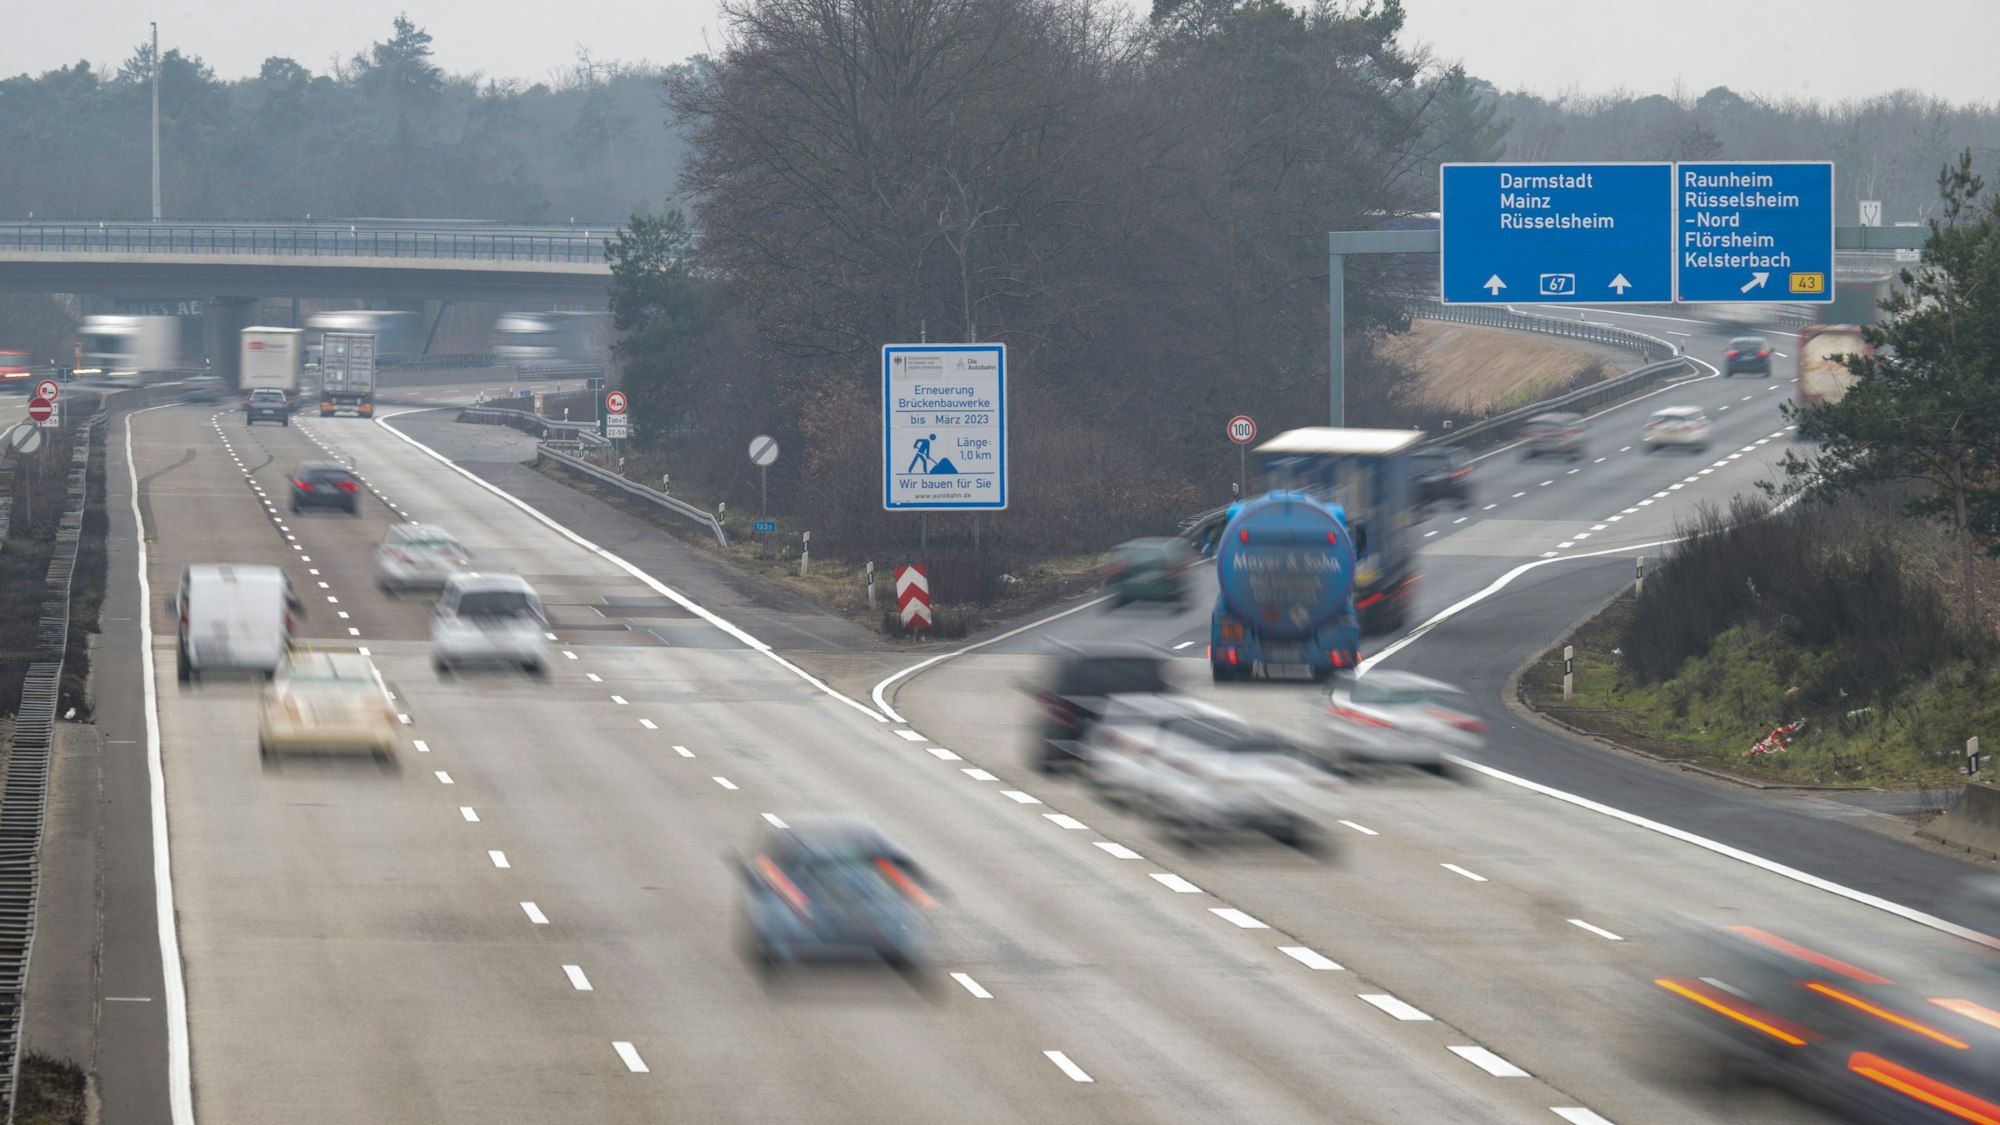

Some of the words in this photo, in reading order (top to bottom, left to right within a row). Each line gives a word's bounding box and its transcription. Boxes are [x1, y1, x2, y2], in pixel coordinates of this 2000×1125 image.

[1500, 173, 1593, 189] Darmstadt
[1685, 171, 1773, 188] Raunheim
[1500, 194, 1551, 209] Mainz
[1685, 191, 1799, 208] Rüsselsheim
[1500, 213, 1614, 230] Rüsselsheim
[1685, 231, 1775, 248] Flörsheim
[1685, 251, 1791, 268] Kelsterbach
[1550, 278, 1565, 291] 67
[1798, 276, 1815, 289] 43
[914, 385, 974, 397] Erneuerung
[898, 398, 990, 409] Brückenbauwerke
[910, 415, 926, 425] bis
[935, 414, 961, 425] März
[964, 414, 989, 425] 2023
[1234, 423, 1250, 437] 100
[957, 437, 992, 449] Länge:
[975, 450, 992, 460] km
[899, 479, 918, 489] Wir
[921, 479, 953, 489] bauen
[956, 478, 972, 489] für
[976, 478, 992, 489] Sie
[1285, 551, 1299, 572] &
